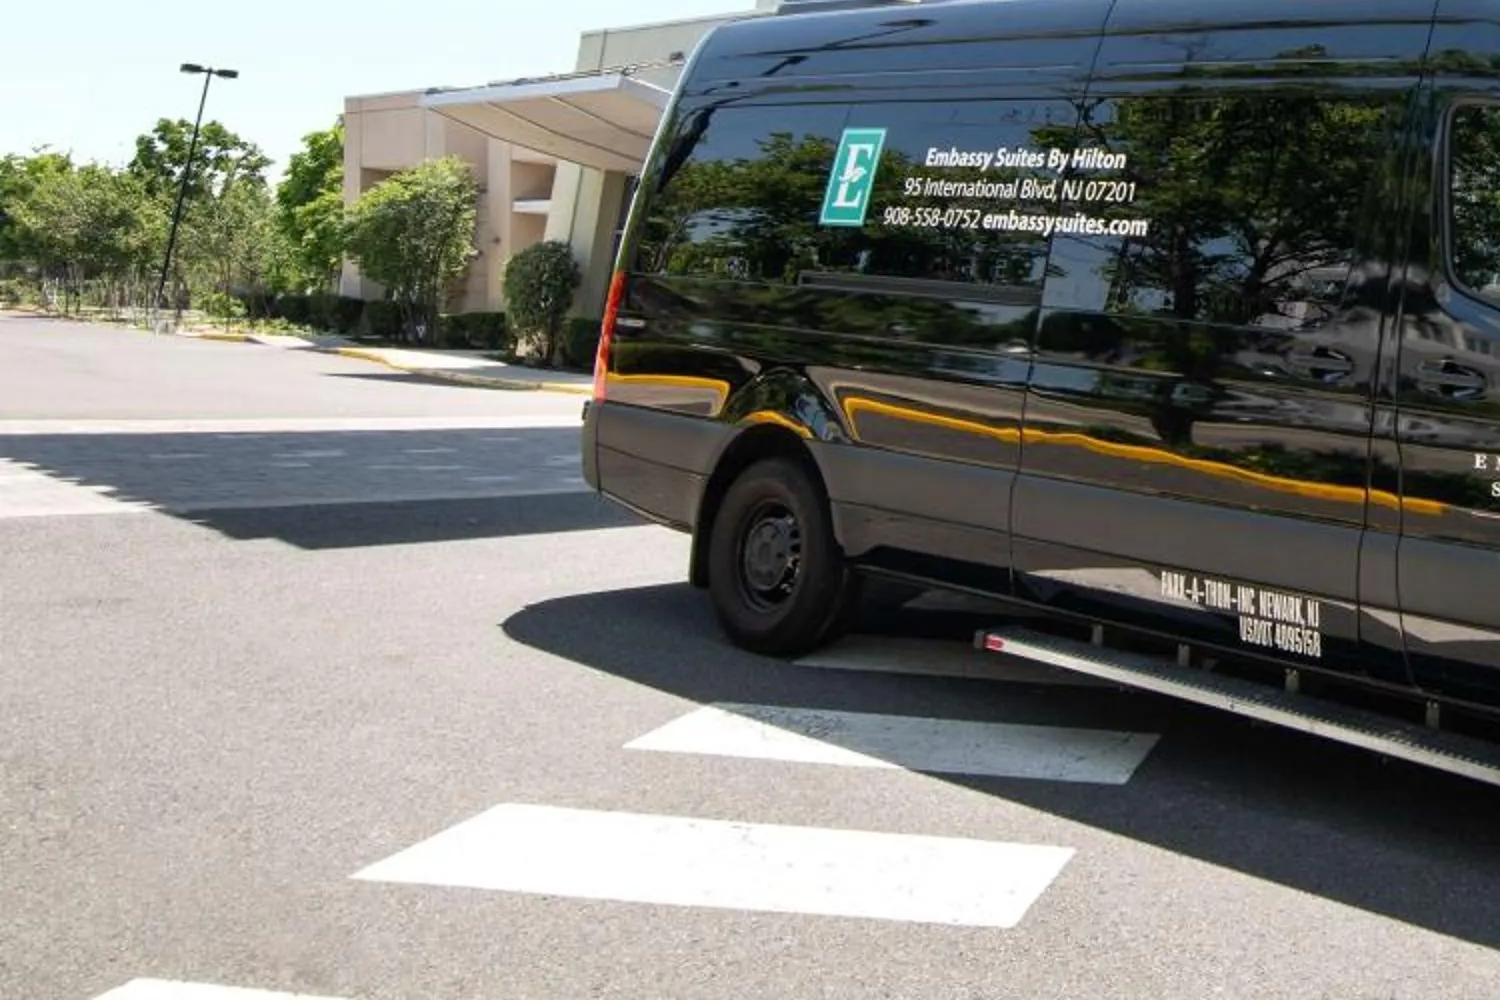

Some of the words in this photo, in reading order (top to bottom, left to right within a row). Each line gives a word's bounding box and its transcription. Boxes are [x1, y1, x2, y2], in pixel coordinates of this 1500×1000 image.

[925, 148, 992, 172] Embassy
[996, 148, 1045, 169] Suites
[1048, 149, 1069, 173] By
[1071, 148, 1127, 170] Hilton
[831, 143, 874, 208] E
[903, 177, 922, 196] 95
[923, 177, 1017, 199] International
[1020, 178, 1058, 203] Blvd,
[1061, 180, 1083, 201] NJ
[1084, 181, 1136, 203] 07201
[883, 207, 980, 229] 908-558-0752
[982, 211, 1148, 237] embassysuites.com
[1307, 599, 1319, 628] NJ
[1239, 615, 1273, 647] USDOT
